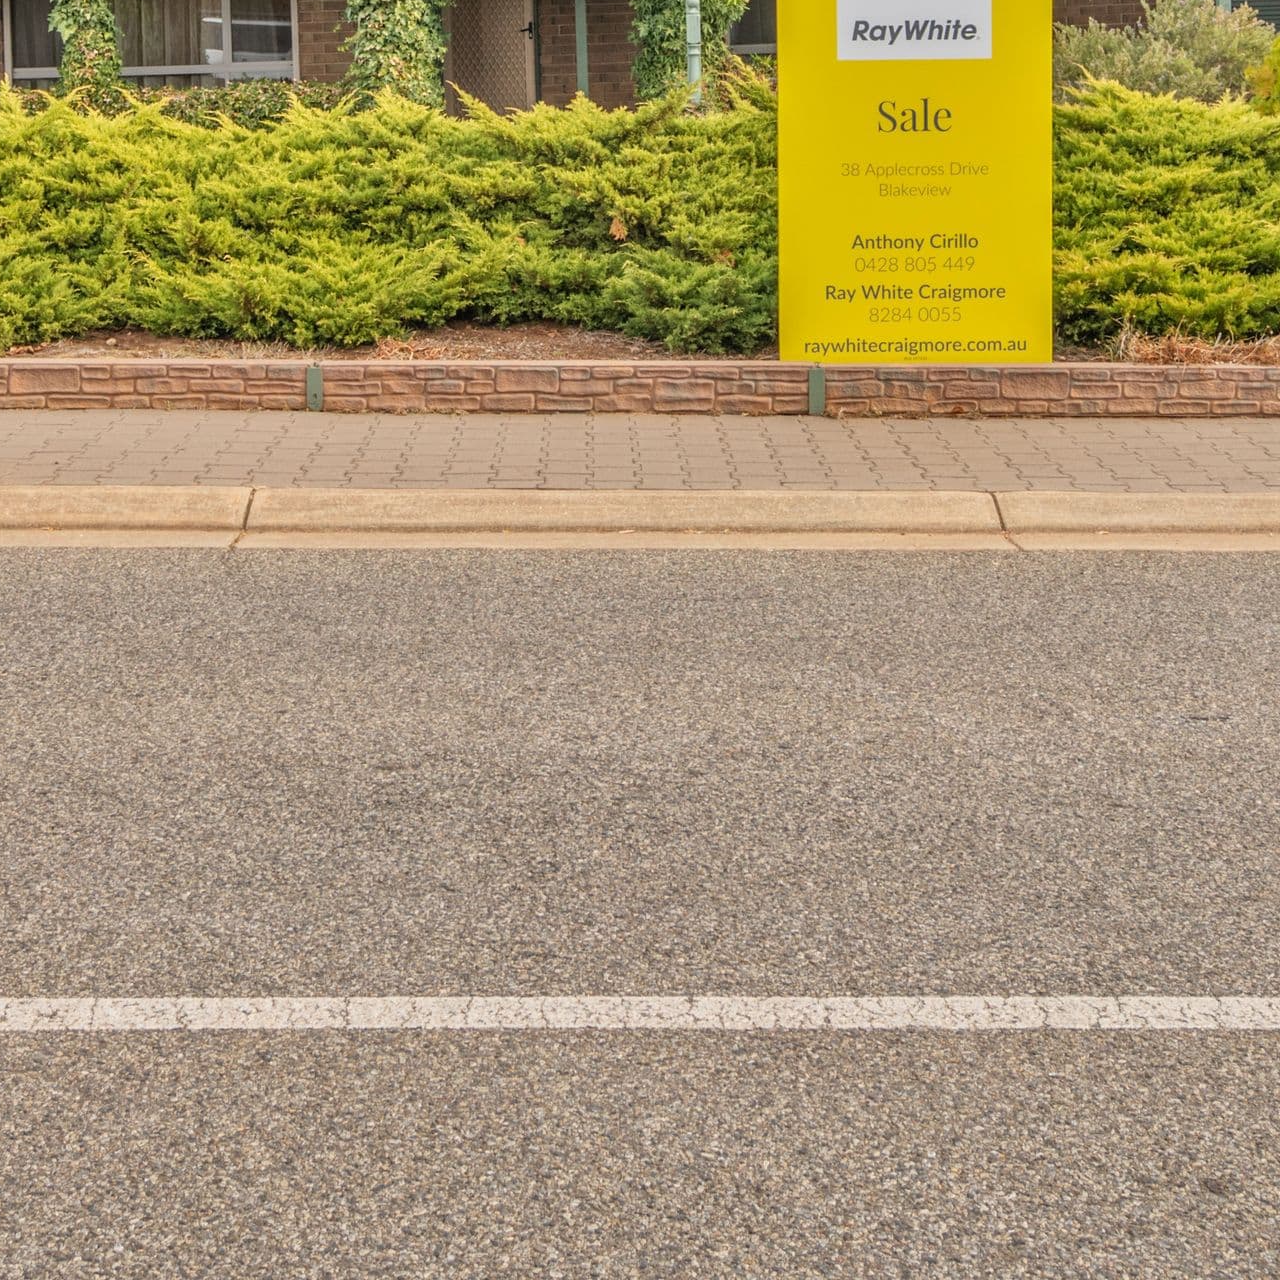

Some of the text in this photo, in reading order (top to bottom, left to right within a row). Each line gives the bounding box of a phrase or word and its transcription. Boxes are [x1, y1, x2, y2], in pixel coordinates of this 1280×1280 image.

[877, 97, 952, 133] Sale
[840, 161, 989, 179] 38 Applecross Drive
[879, 183, 952, 197] Blakeview
[851, 233, 979, 252] Anthony Cirillo
[854, 256, 976, 272] 0428 805 449
[825, 283, 1007, 303] Ray White Craigmore
[869, 307, 962, 322] 8284 0055
[804, 337, 1027, 356] raywhitecraigmore.com.au
